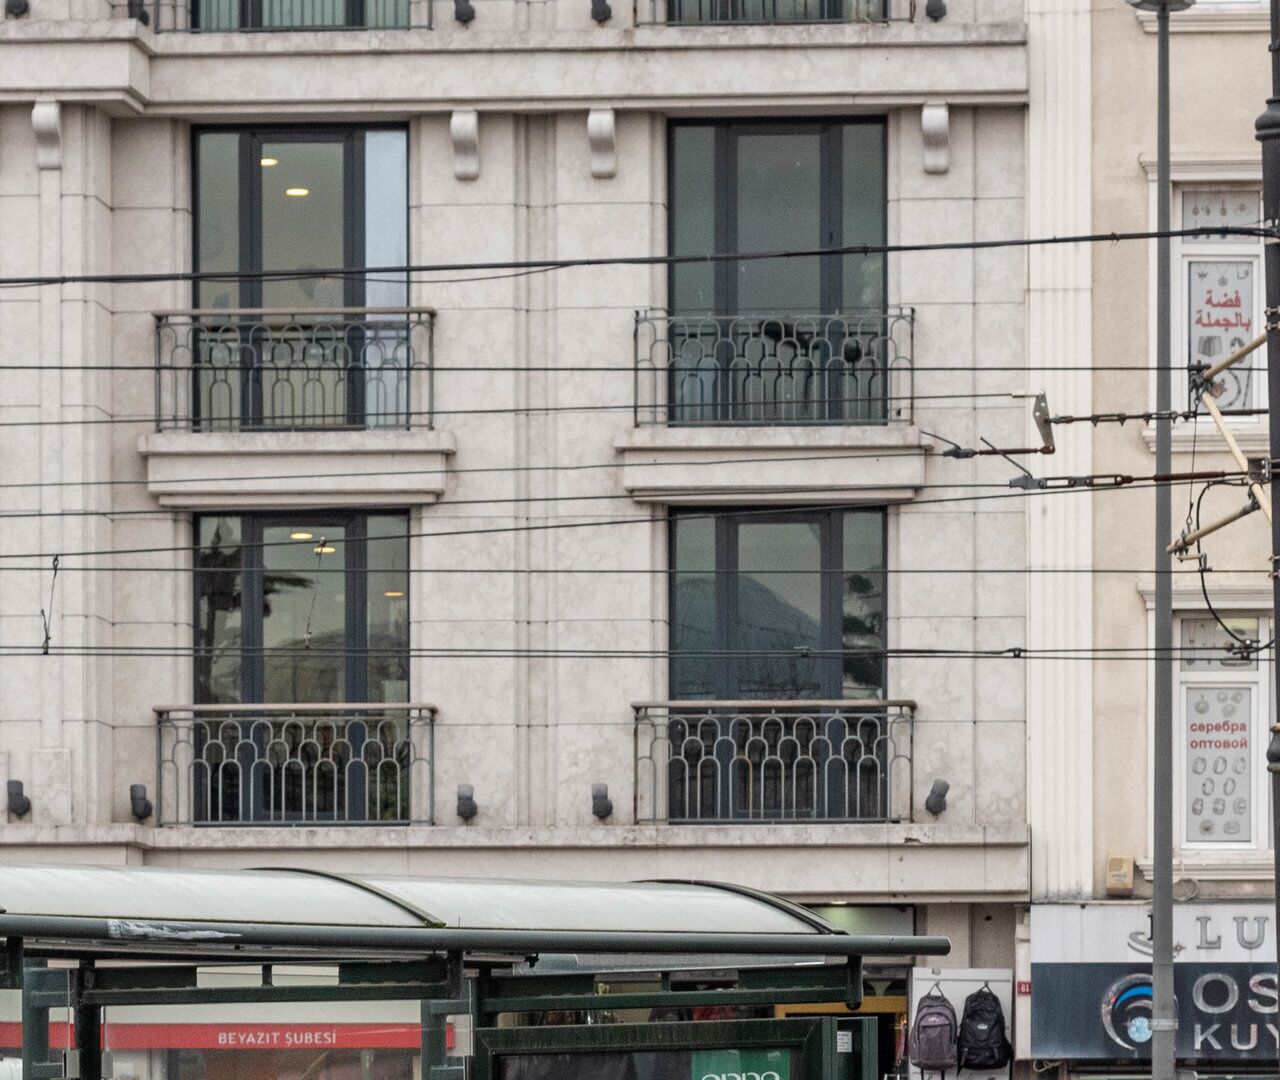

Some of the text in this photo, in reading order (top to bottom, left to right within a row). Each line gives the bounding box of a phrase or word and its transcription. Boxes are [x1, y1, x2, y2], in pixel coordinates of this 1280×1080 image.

[1205, 290, 1242, 308] فضة
[1195, 313, 1251, 332] بالجملة
[1190, 737, 1248, 749] оптовой
[218, 1030, 337, 1048] BEYAZIT ŞUBESİ
